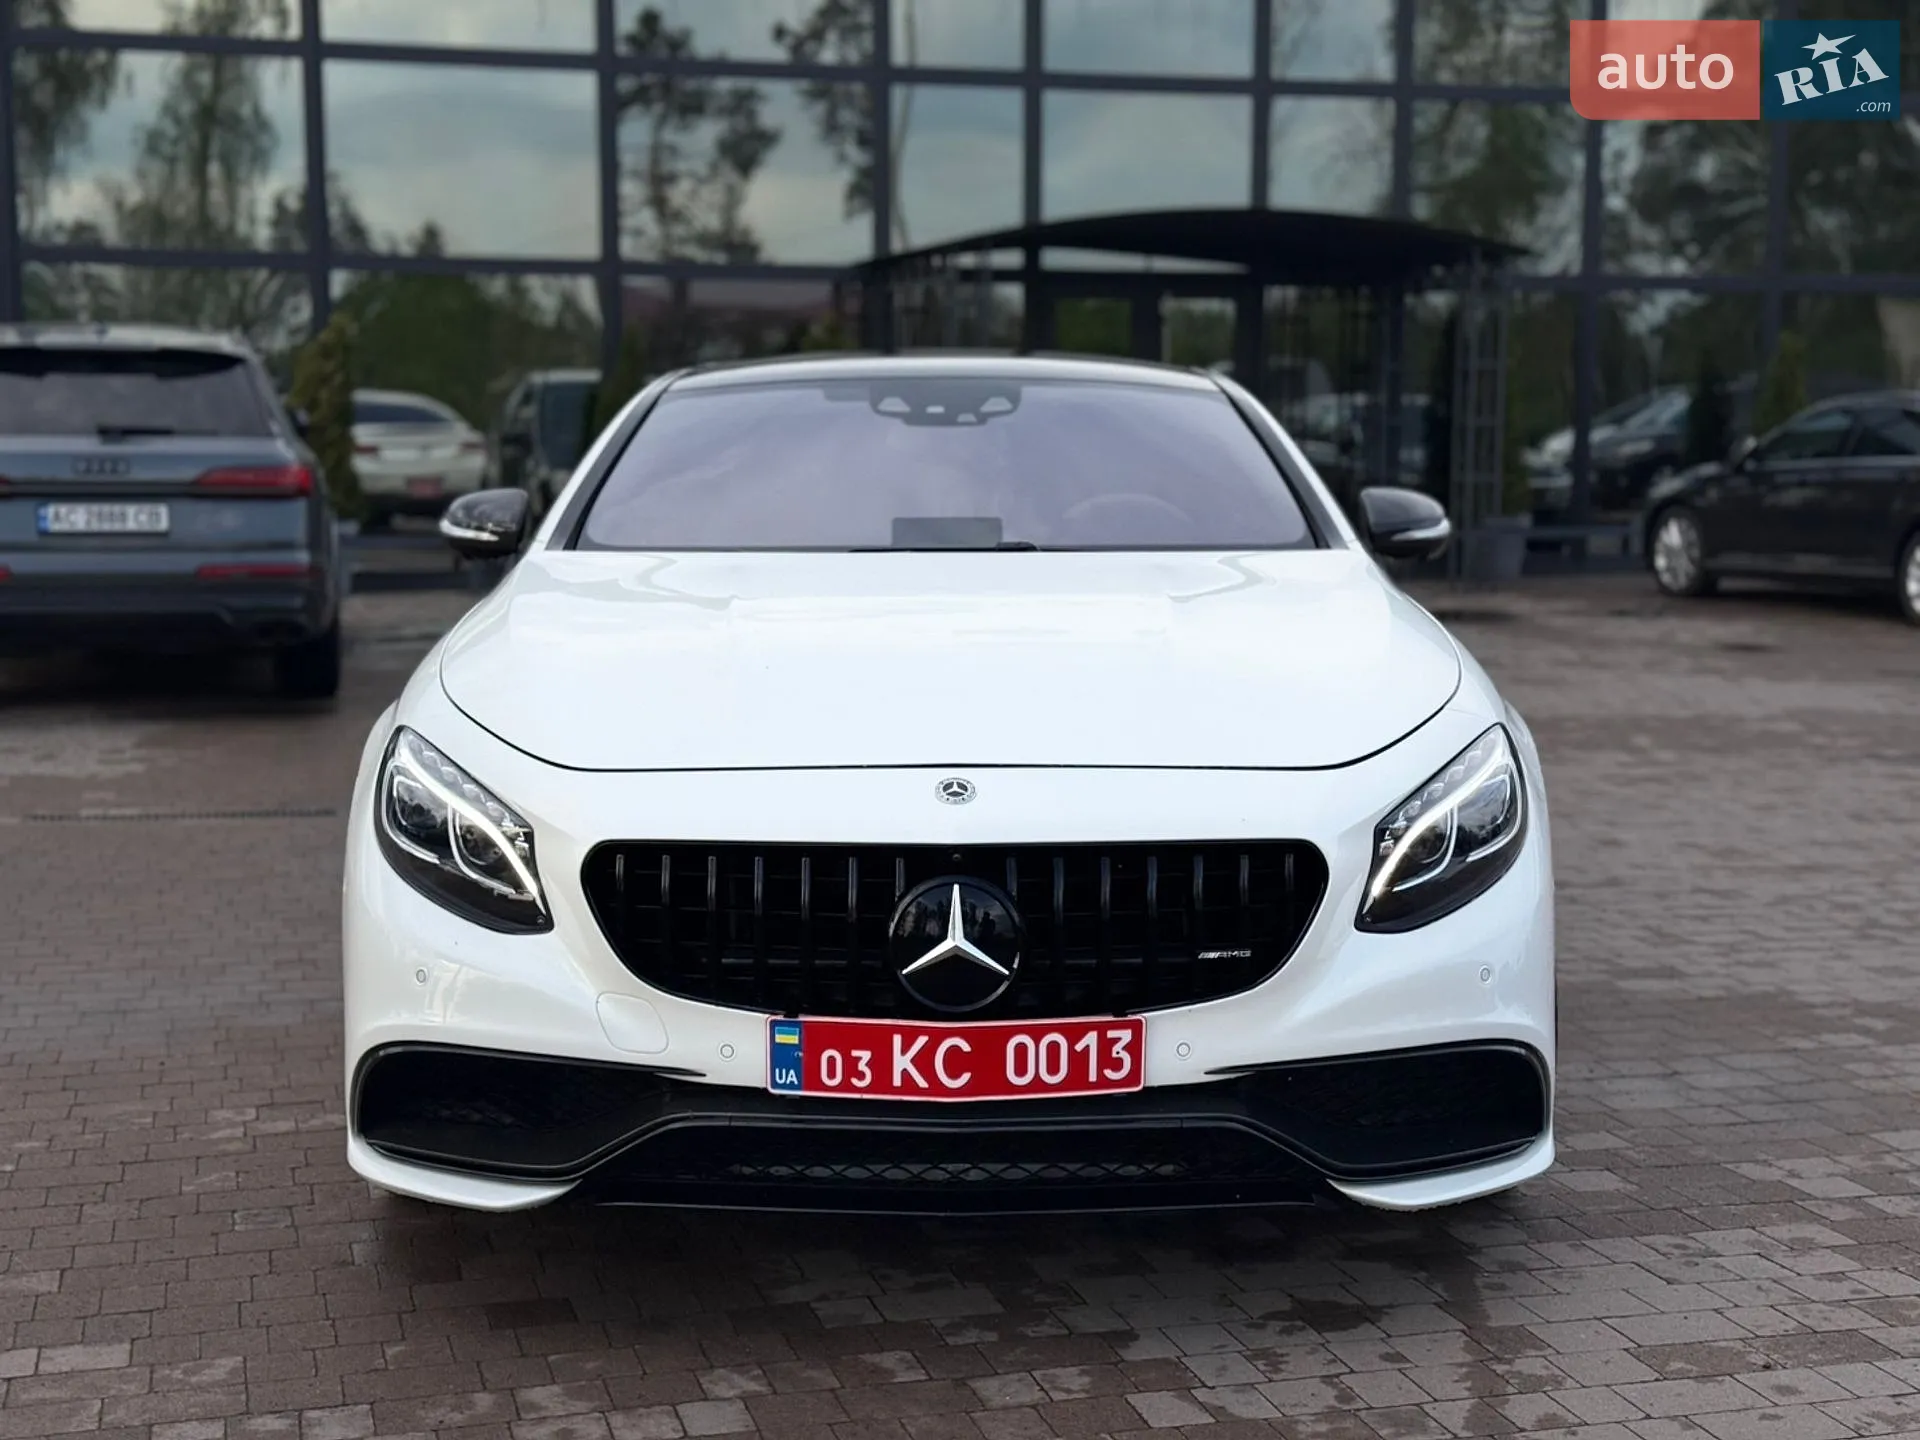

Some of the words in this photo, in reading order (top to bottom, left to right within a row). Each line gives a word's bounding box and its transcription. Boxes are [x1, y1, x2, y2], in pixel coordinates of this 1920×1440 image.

[775, 1069, 798, 1085] UA
[820, 1049, 872, 1087] 03
[892, 1034, 971, 1088] KC
[1006, 1030, 1132, 1085] 0013
